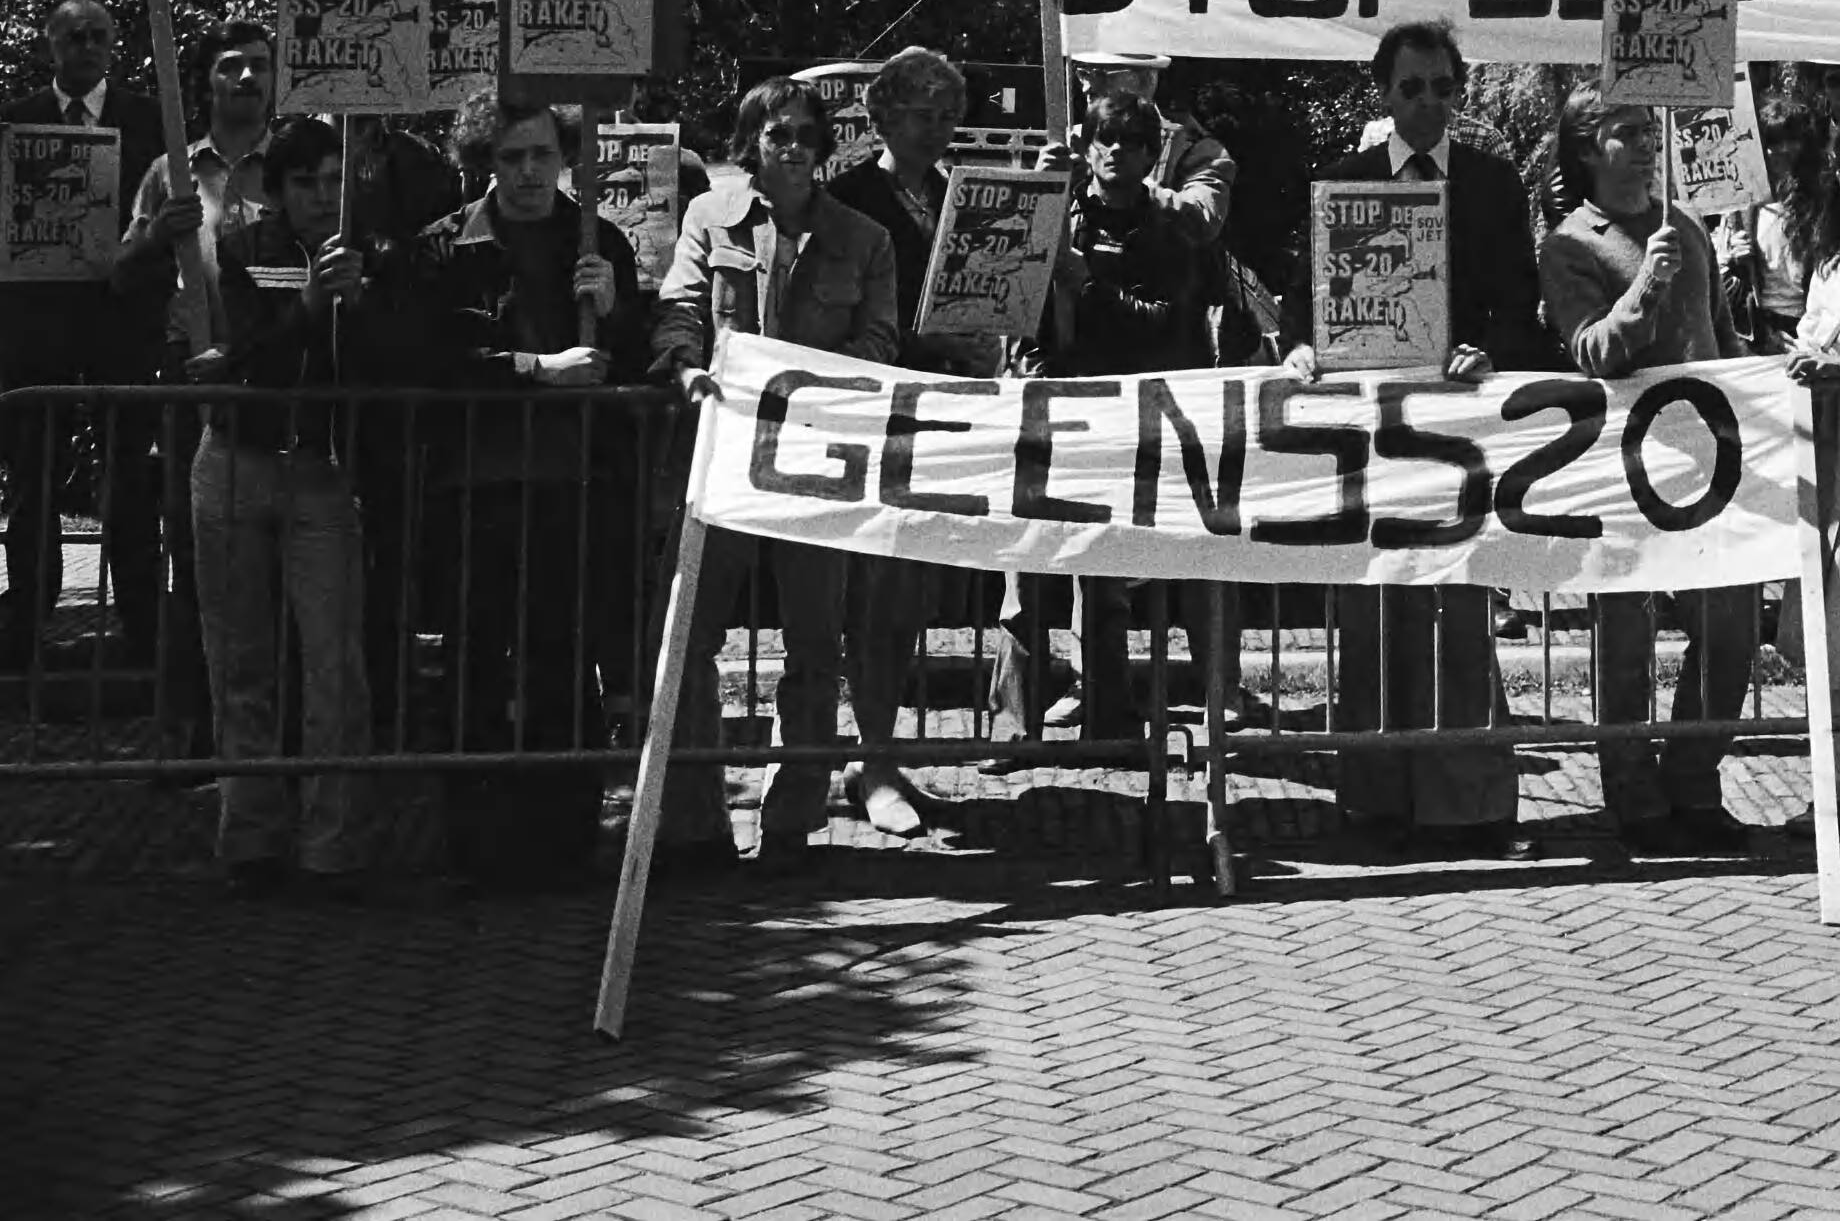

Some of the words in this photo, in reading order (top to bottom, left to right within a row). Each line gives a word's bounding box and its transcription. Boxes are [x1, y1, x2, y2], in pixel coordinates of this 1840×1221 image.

[1674, 124, 1721, 148] SS-20
[9, 138, 62, 159] STOP
[71, 144, 91, 160] DE
[628, 144, 649, 162] DE
[953, 184, 1011, 209] STOP
[1017, 193, 1039, 211] DE
[1323, 200, 1382, 225] STOP
[1391, 206, 1413, 224] DE
[941, 232, 1009, 256] SS-20
[1323, 252, 1393, 277] SS-20
